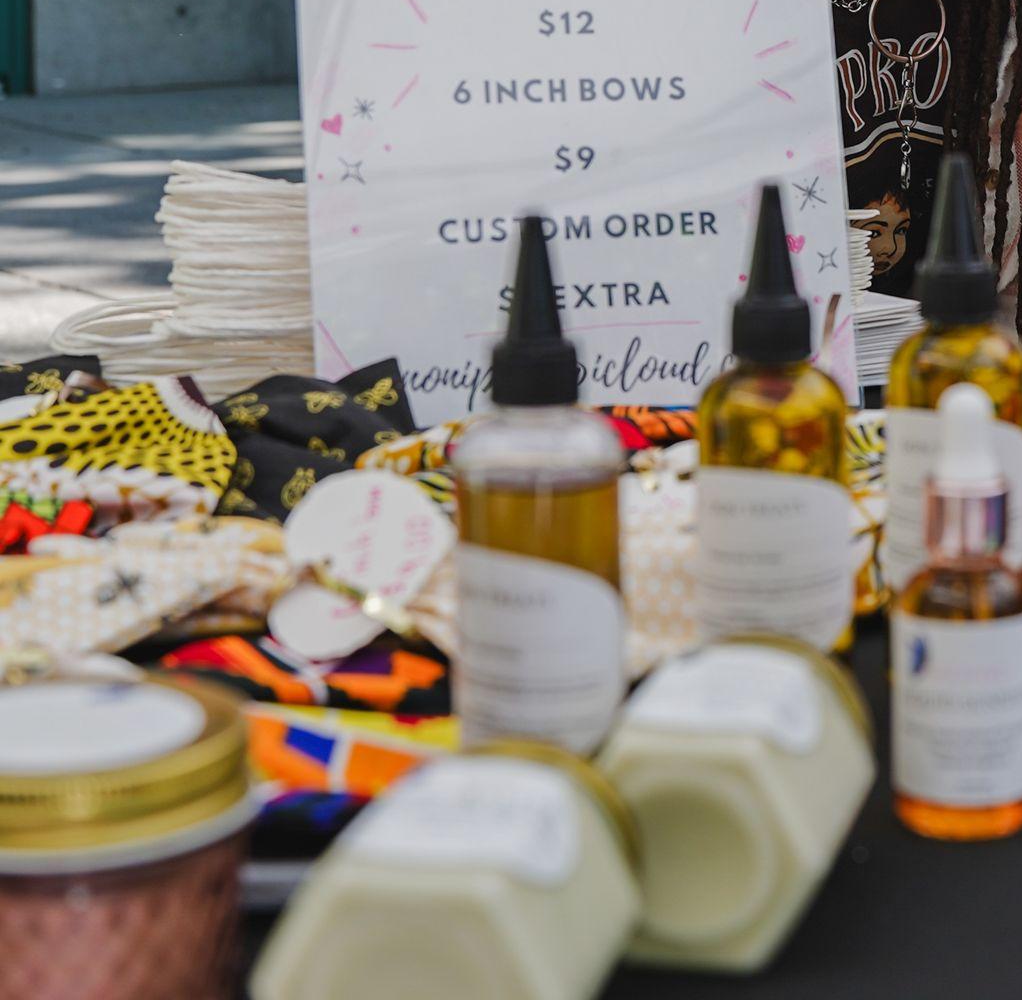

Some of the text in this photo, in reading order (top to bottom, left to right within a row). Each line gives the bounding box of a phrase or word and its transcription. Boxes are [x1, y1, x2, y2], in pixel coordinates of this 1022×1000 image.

[538, 10, 596, 38] $12
[453, 76, 687, 105] 6 INCH BOWS
[554, 145, 596, 173] $9
[438, 211, 718, 244] CUSOM ORDER
[552, 281, 671, 311] EXTRA
